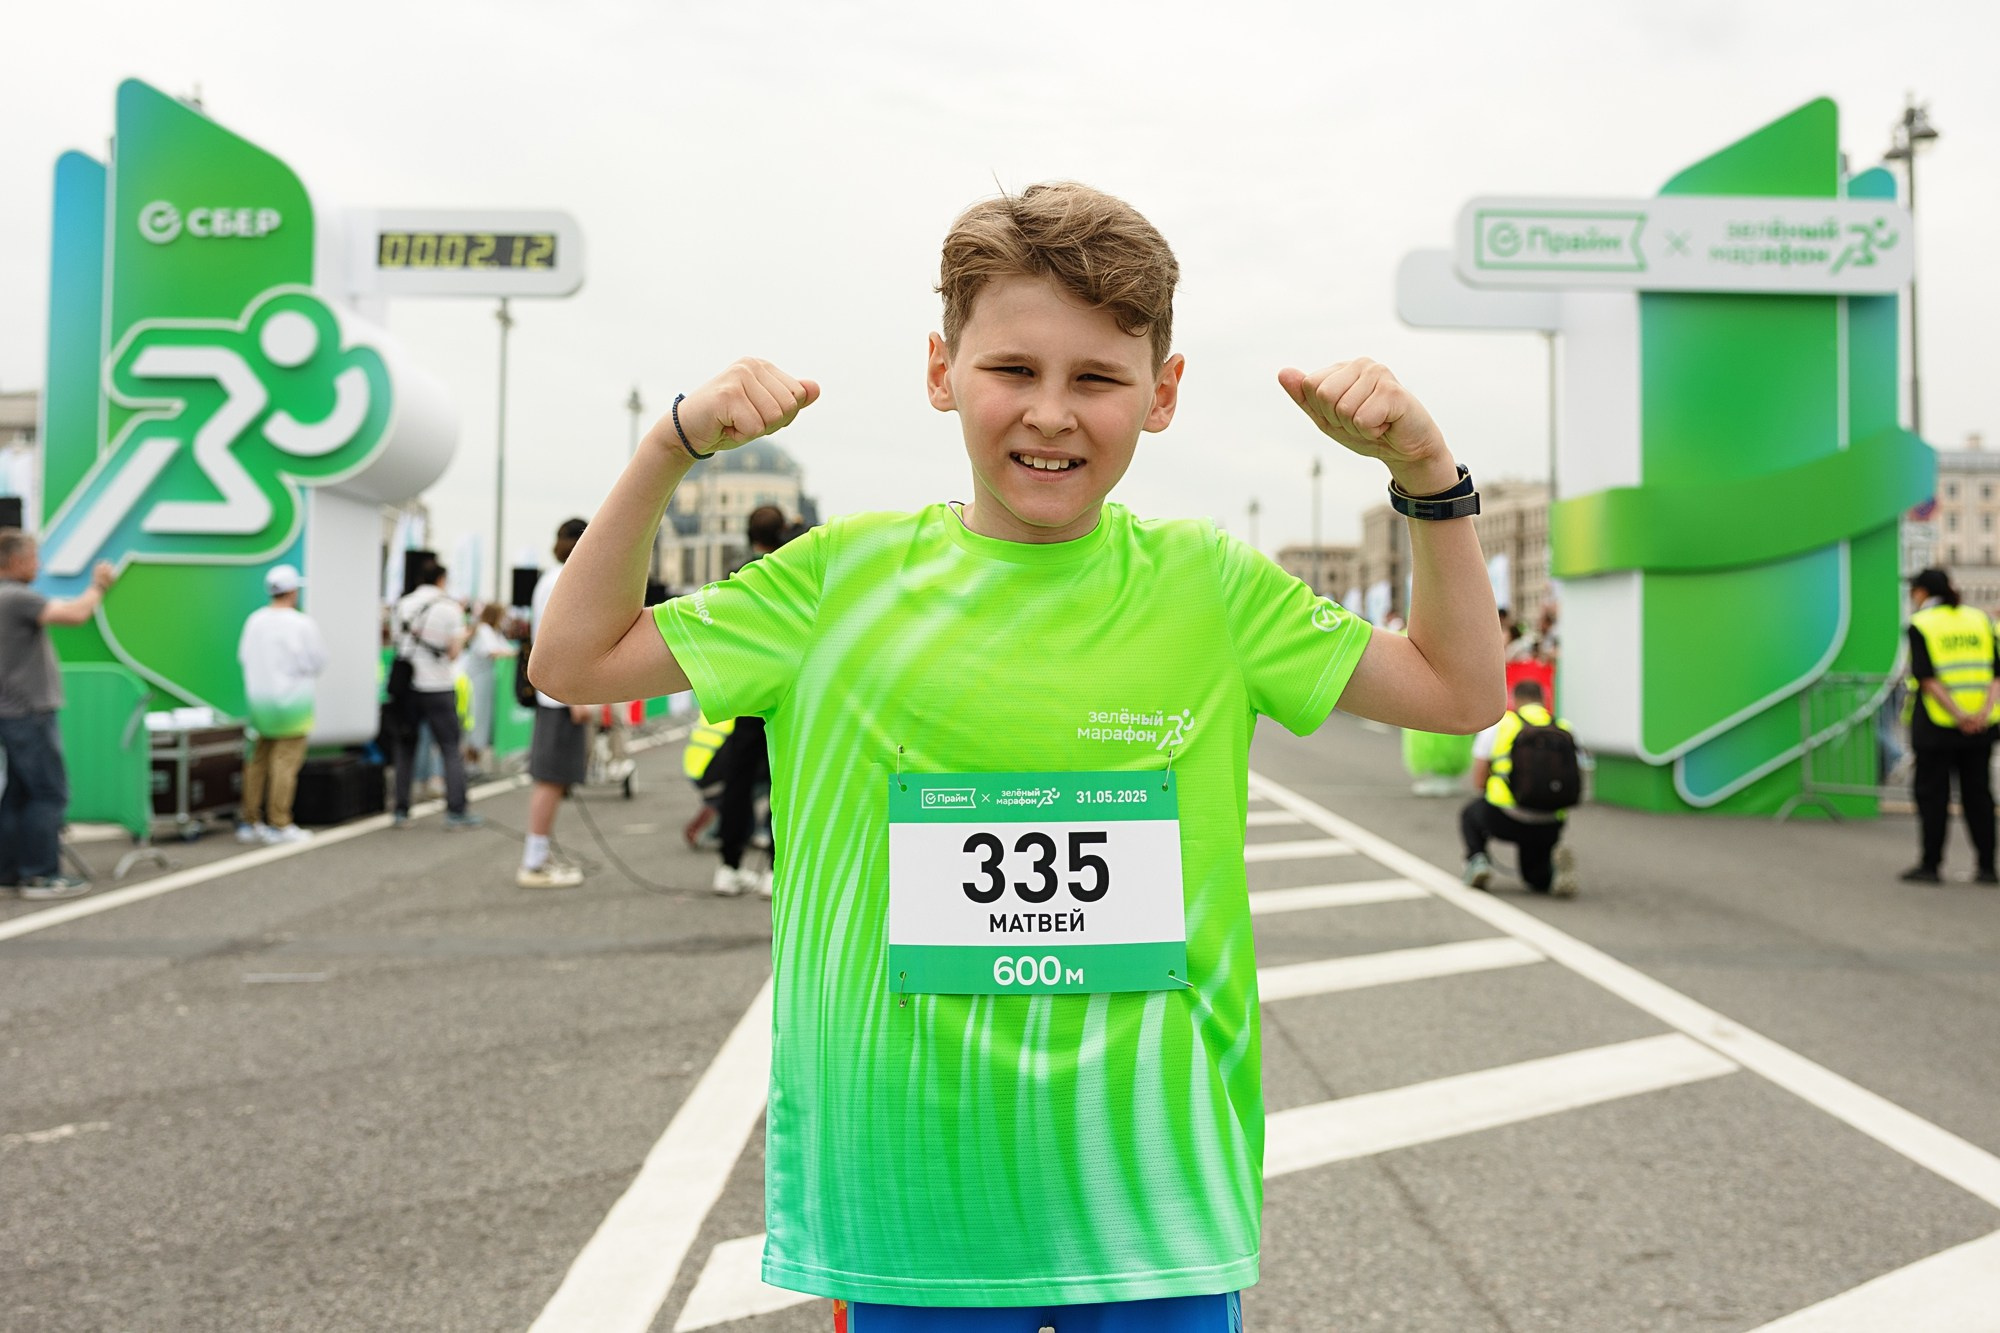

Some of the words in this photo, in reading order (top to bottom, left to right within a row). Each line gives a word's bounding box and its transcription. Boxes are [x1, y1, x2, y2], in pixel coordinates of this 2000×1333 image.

[187, 206, 282, 238] СБЕР
[1526, 225, 1623, 256] Прайм
[1087, 708, 1164, 727] зелёный
[1076, 726, 1157, 743] марафон
[937, 792, 968, 805] Прайм
[1001, 787, 1041, 798] зелёный
[1076, 789, 1148, 804] 31.05.2025
[996, 797, 1037, 807] марафон
[962, 831, 1110, 904] 335
[989, 908, 1086, 933] МАТВЕЙ
